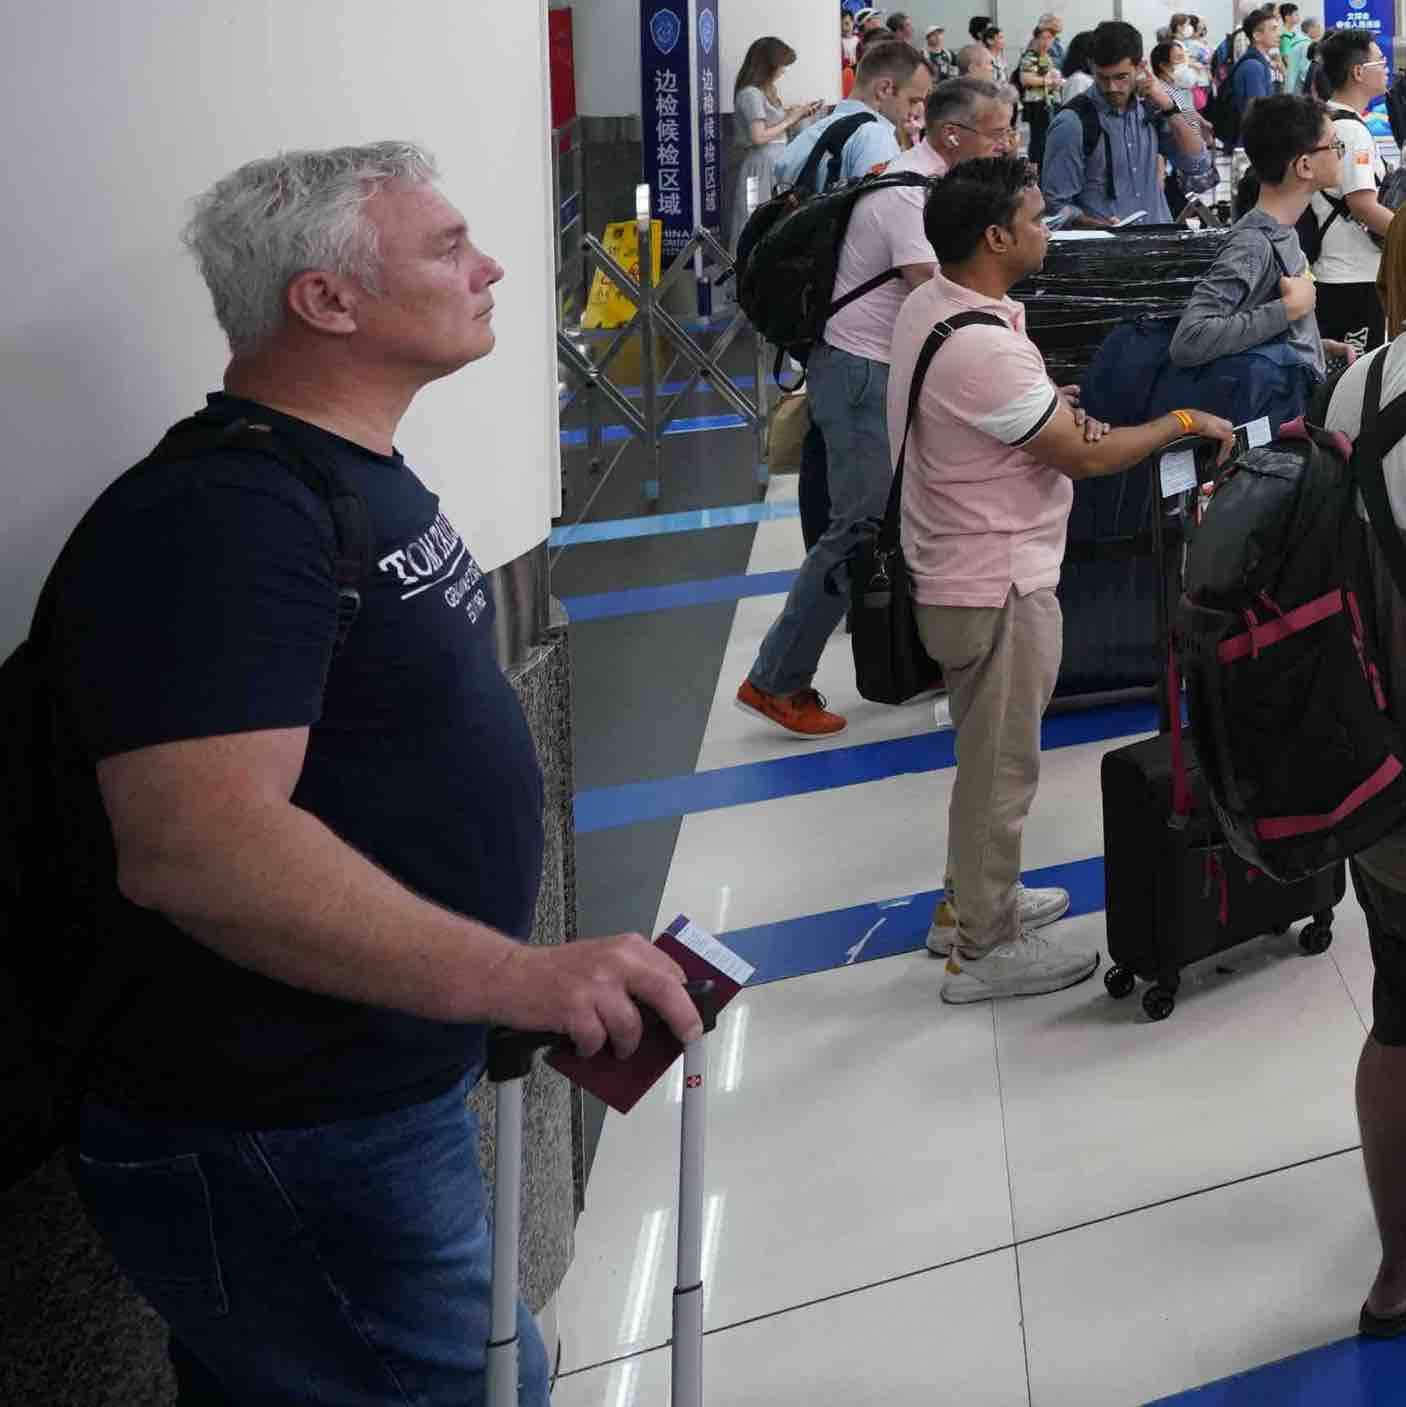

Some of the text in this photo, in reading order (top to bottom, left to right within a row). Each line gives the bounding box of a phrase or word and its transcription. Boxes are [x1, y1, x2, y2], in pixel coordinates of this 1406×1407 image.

[655, 69, 682, 216] 边检候检区域
[378, 533, 443, 585] TOM
